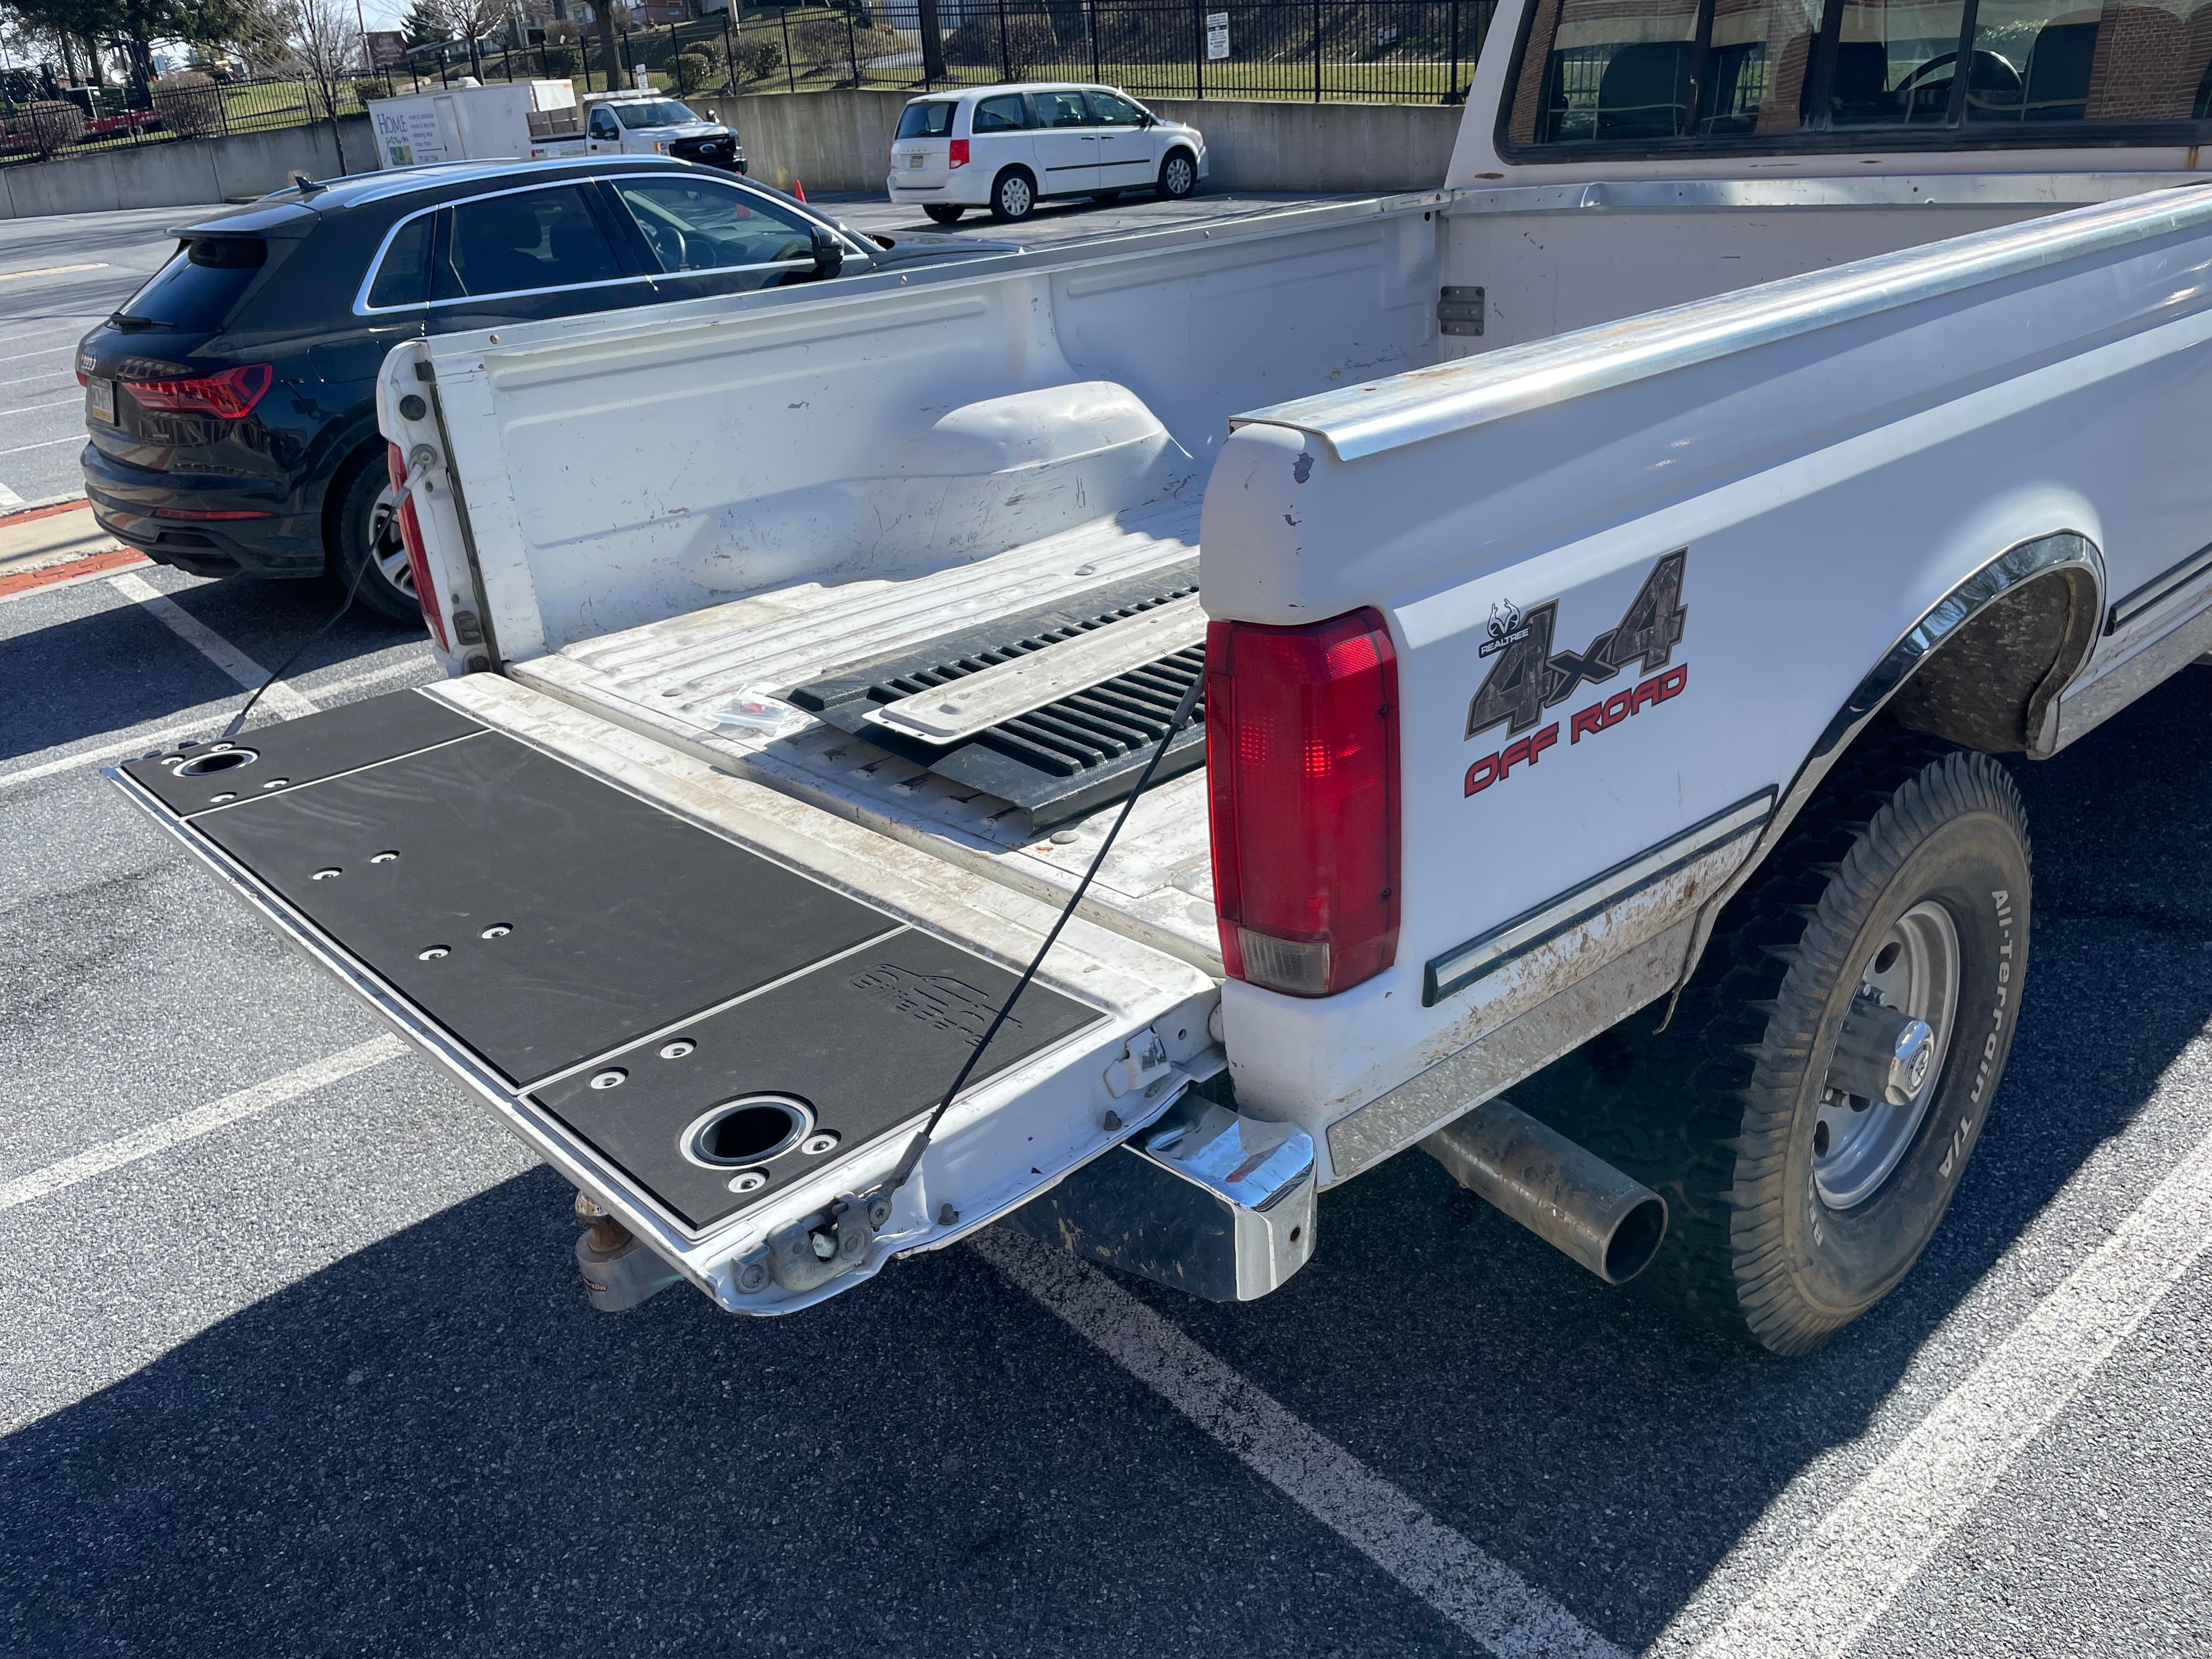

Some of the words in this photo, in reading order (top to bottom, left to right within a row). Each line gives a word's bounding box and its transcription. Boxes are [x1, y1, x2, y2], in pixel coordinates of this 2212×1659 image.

[1481, 627, 1530, 655] REALTREE
[1464, 721, 1560, 799] OFF
[1570, 662, 1688, 746] ROAD
[1938, 1115, 1972, 1178] T/A
